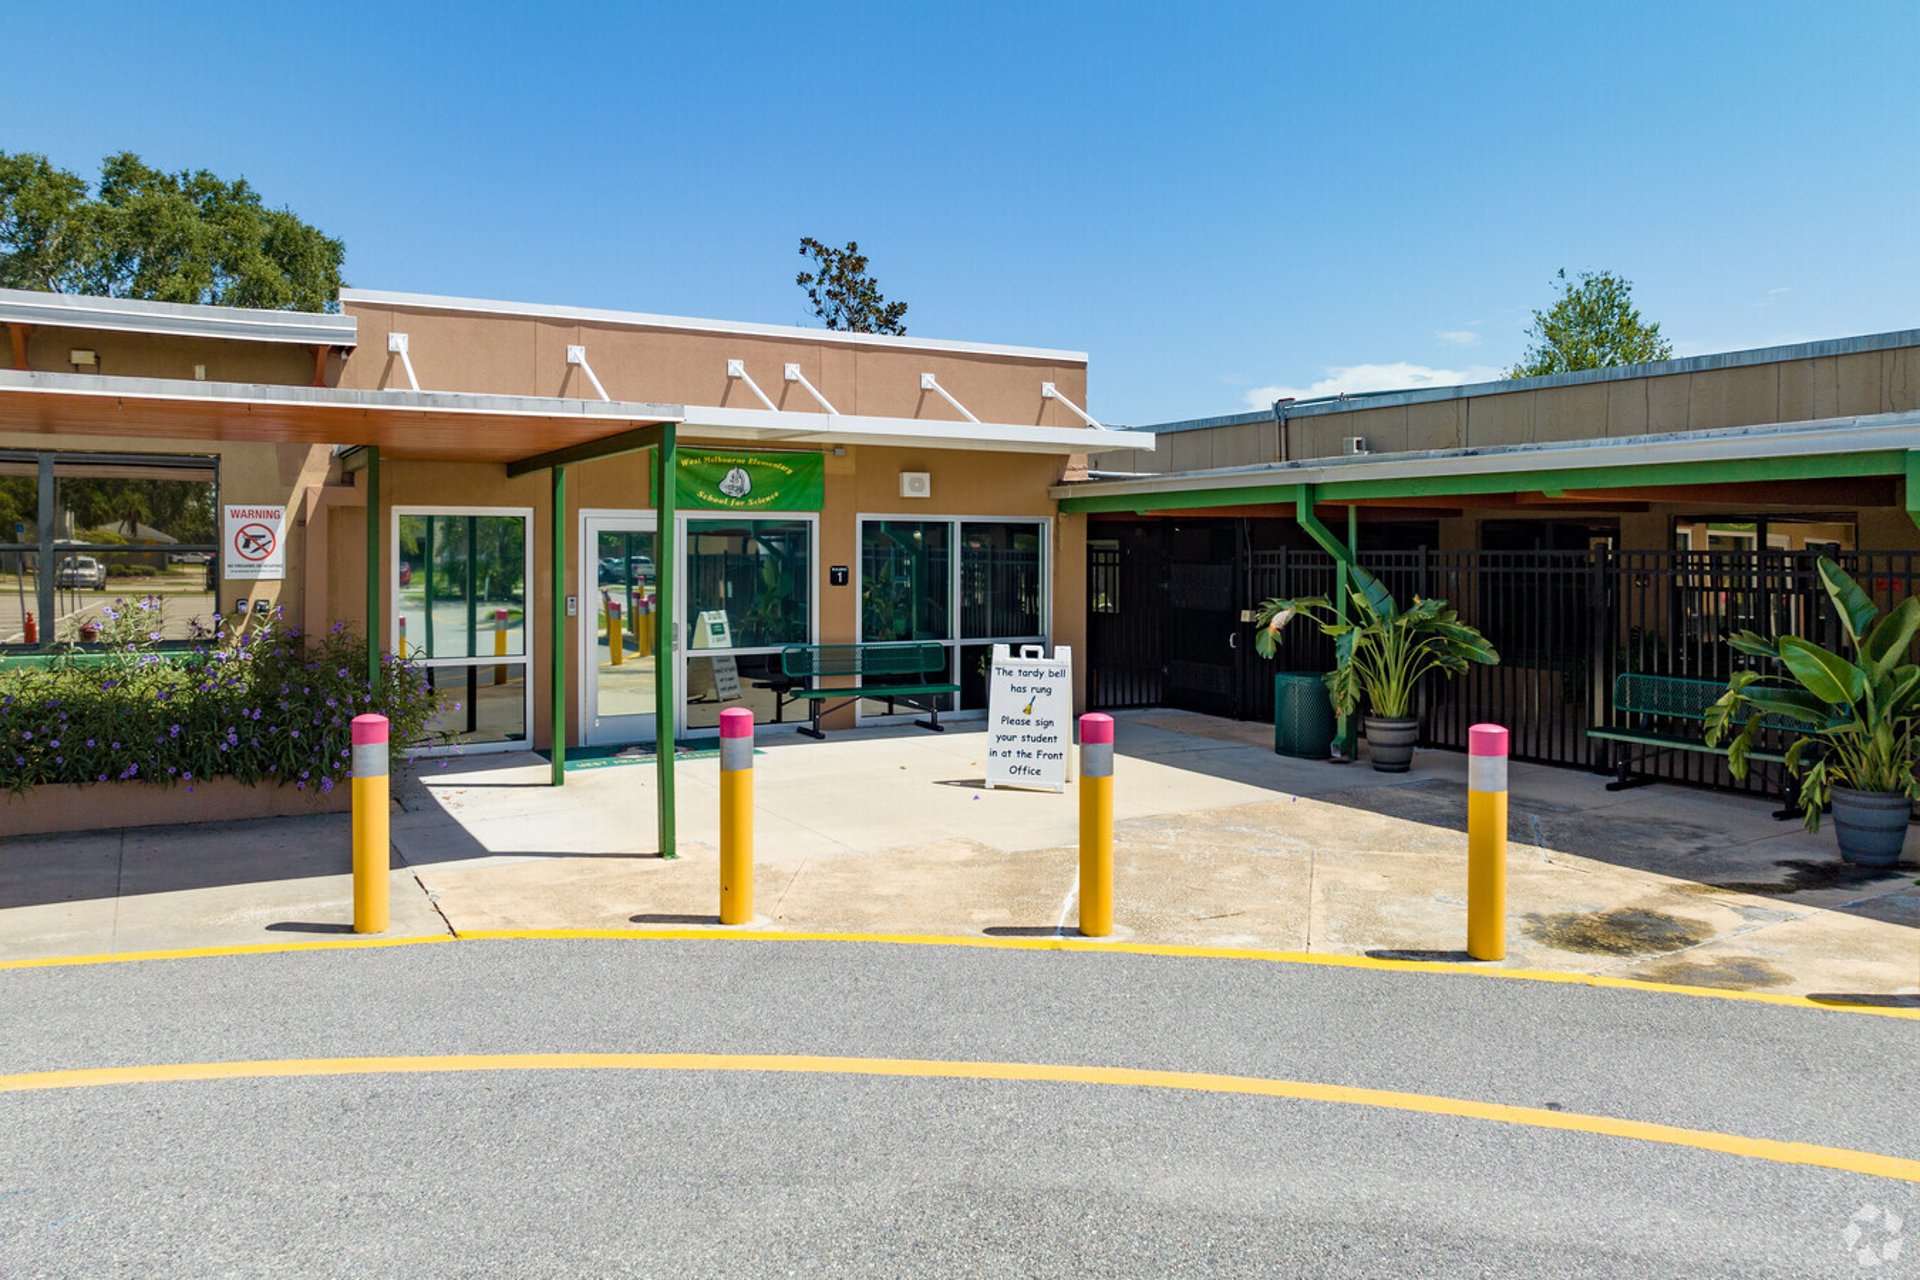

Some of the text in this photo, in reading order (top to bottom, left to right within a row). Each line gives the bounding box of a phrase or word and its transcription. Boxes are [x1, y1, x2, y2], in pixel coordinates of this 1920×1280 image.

[680, 456, 793, 475] West Melbourne Elementary
[697, 490, 779, 507] School for Science
[230, 509, 281, 520] WARNING
[837, 571, 842, 583] 1
[995, 667, 1066, 679] The tardy bell
[1010, 684, 1052, 696] has rung
[1001, 715, 1054, 729] Please sign
[996, 733, 1058, 743] your student
[989, 749, 1063, 760] in at the Front
[1009, 765, 1041, 776] Office
